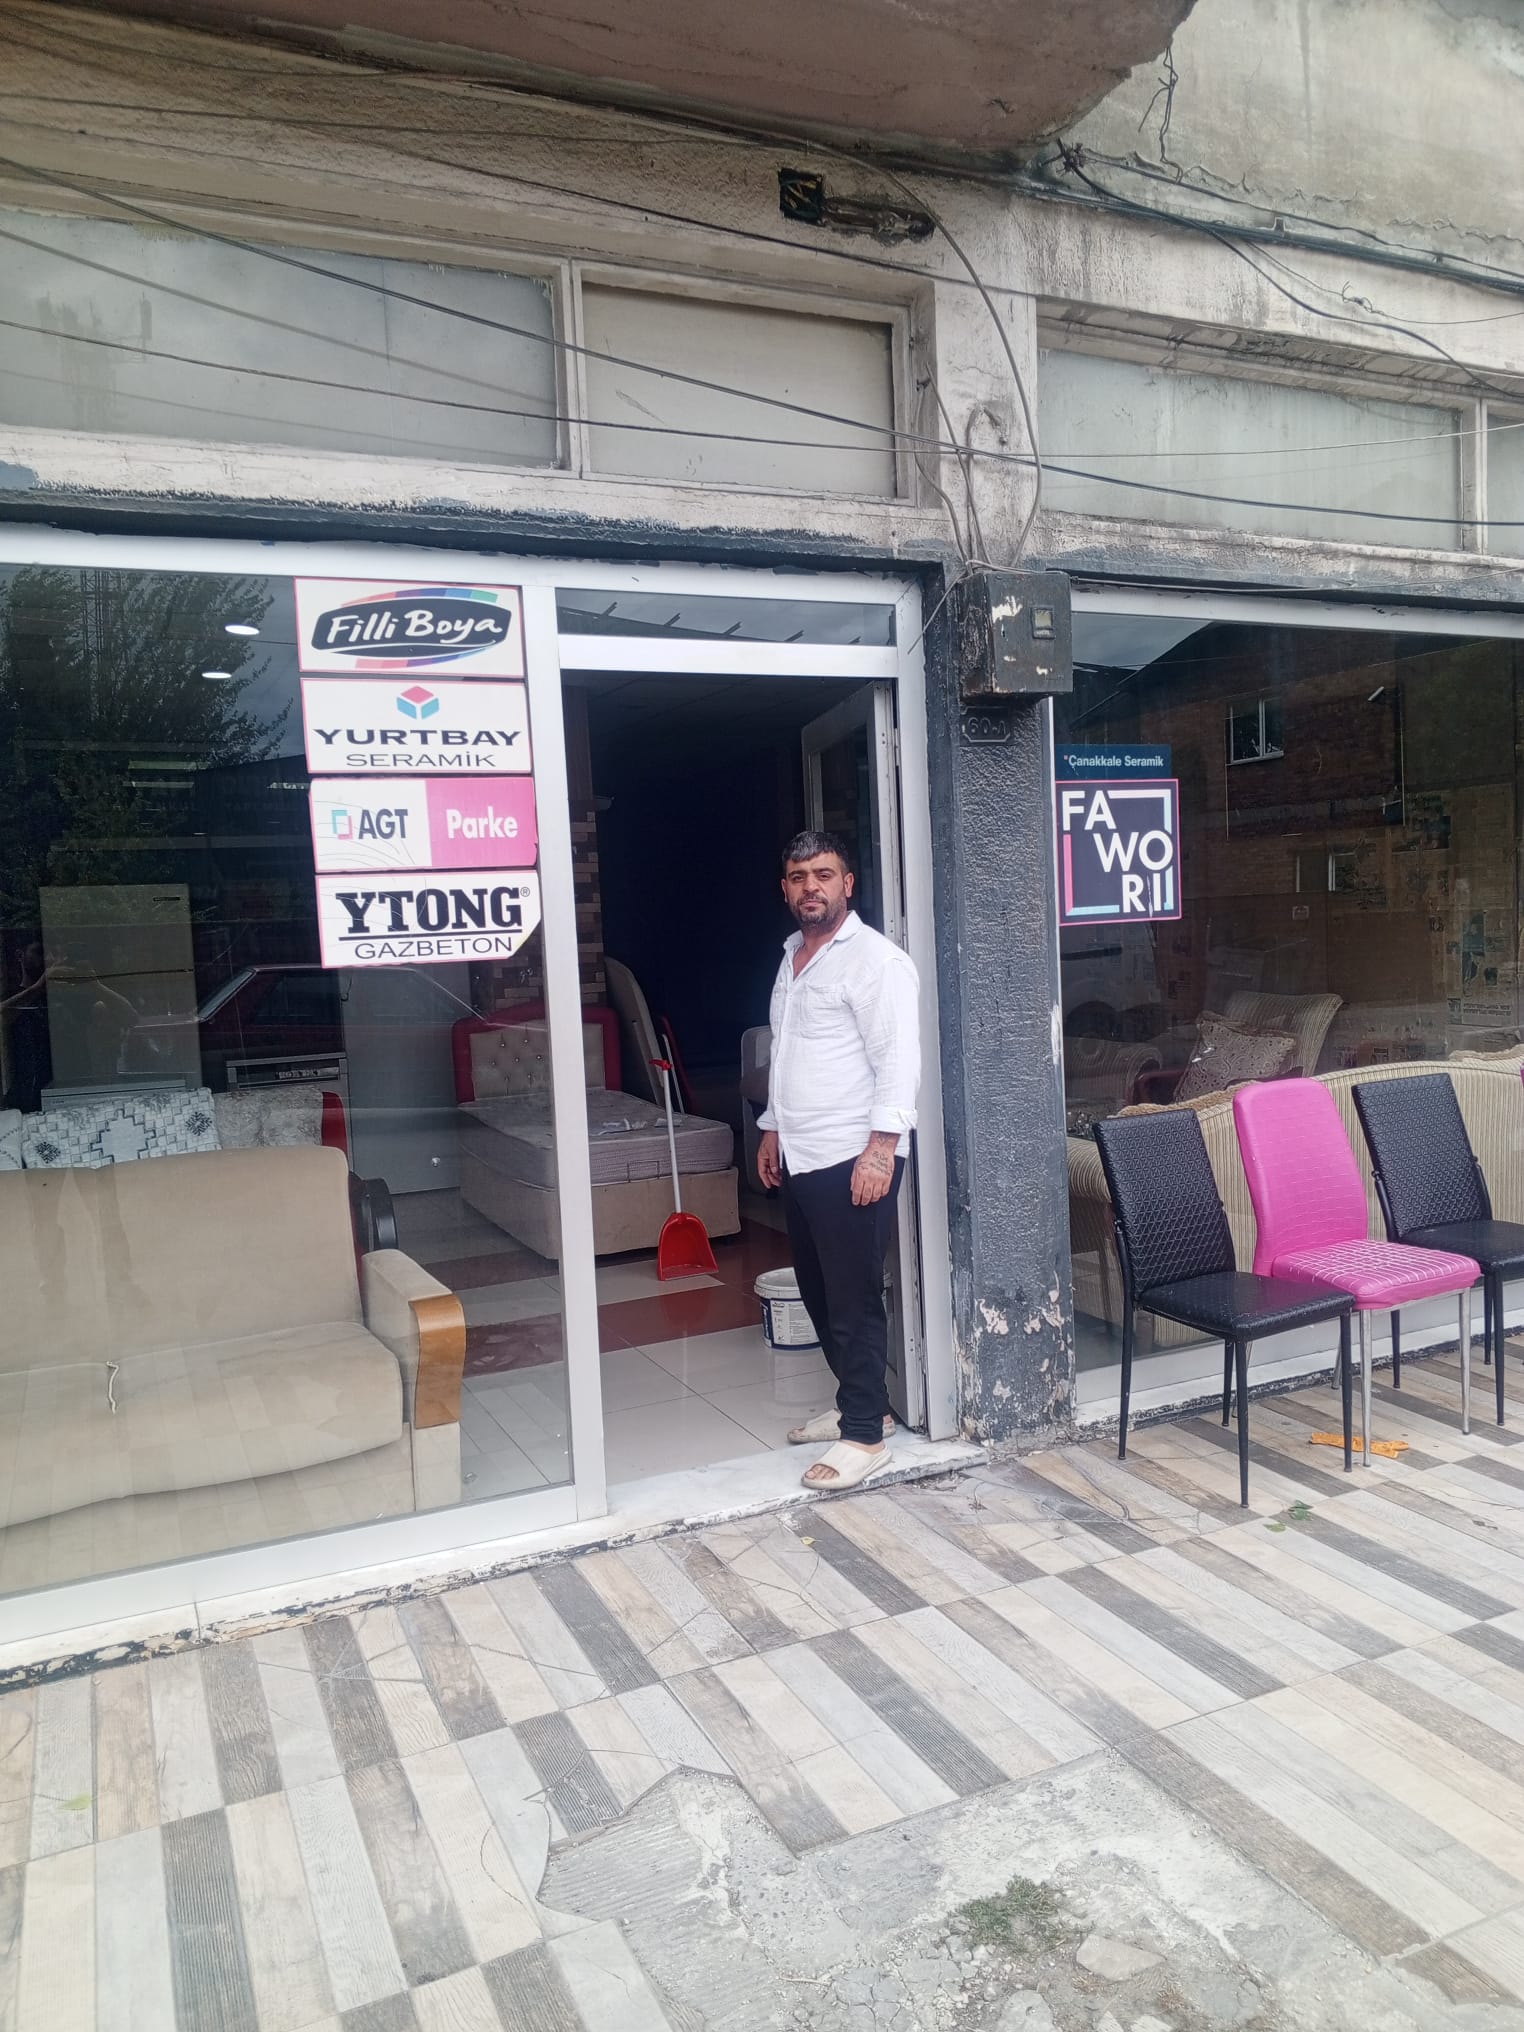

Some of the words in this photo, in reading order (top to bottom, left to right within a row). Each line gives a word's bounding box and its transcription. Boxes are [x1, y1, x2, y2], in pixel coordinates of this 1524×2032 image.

[326, 611, 399, 643] Filli
[403, 609, 503, 646] Boya
[313, 728, 522, 747] YURTBAY
[345, 749, 497, 768] SERAMİK
[1068, 754, 1122, 770] Çanakkale
[1124, 755, 1164, 767] Seramik
[358, 808, 409, 841] AGT
[446, 805, 519, 840] Parke
[354, 936, 513, 960] GAZBETON
